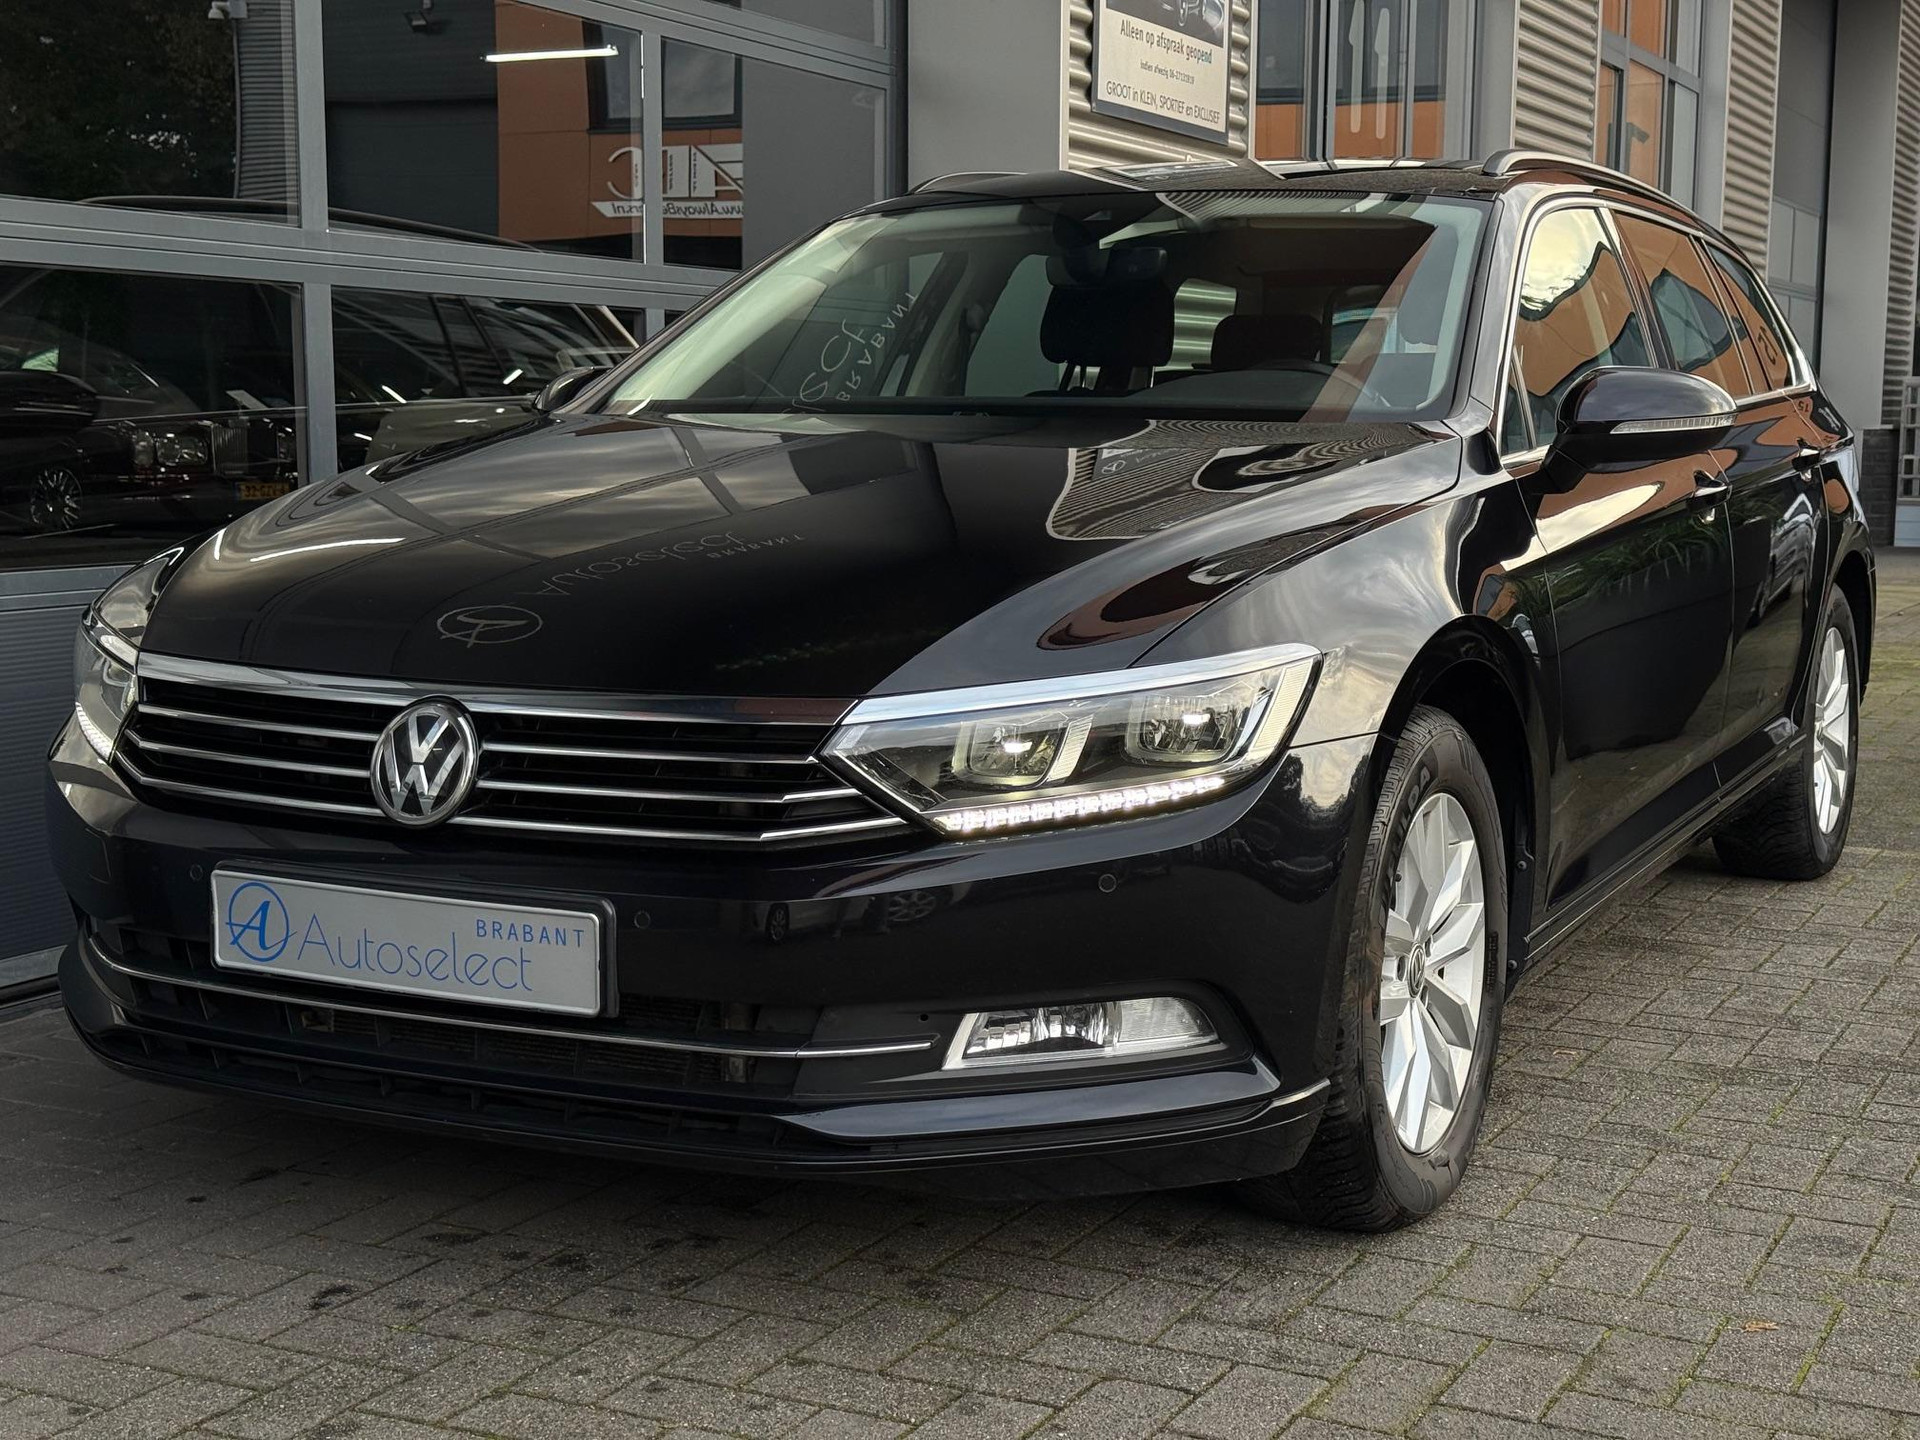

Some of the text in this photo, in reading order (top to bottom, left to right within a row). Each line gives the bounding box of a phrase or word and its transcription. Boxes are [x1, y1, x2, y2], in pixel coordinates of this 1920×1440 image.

[1120, 19, 1213, 64] Alleen op afspraak geopend
[1106, 80, 1131, 99] GROOT
[1132, 87, 1139, 102] in
[1159, 95, 1185, 114] SPORTIEF
[1185, 105, 1194, 117] en
[298, 913, 533, 992] Autoselect
[476, 918, 585, 949] BRABANT
